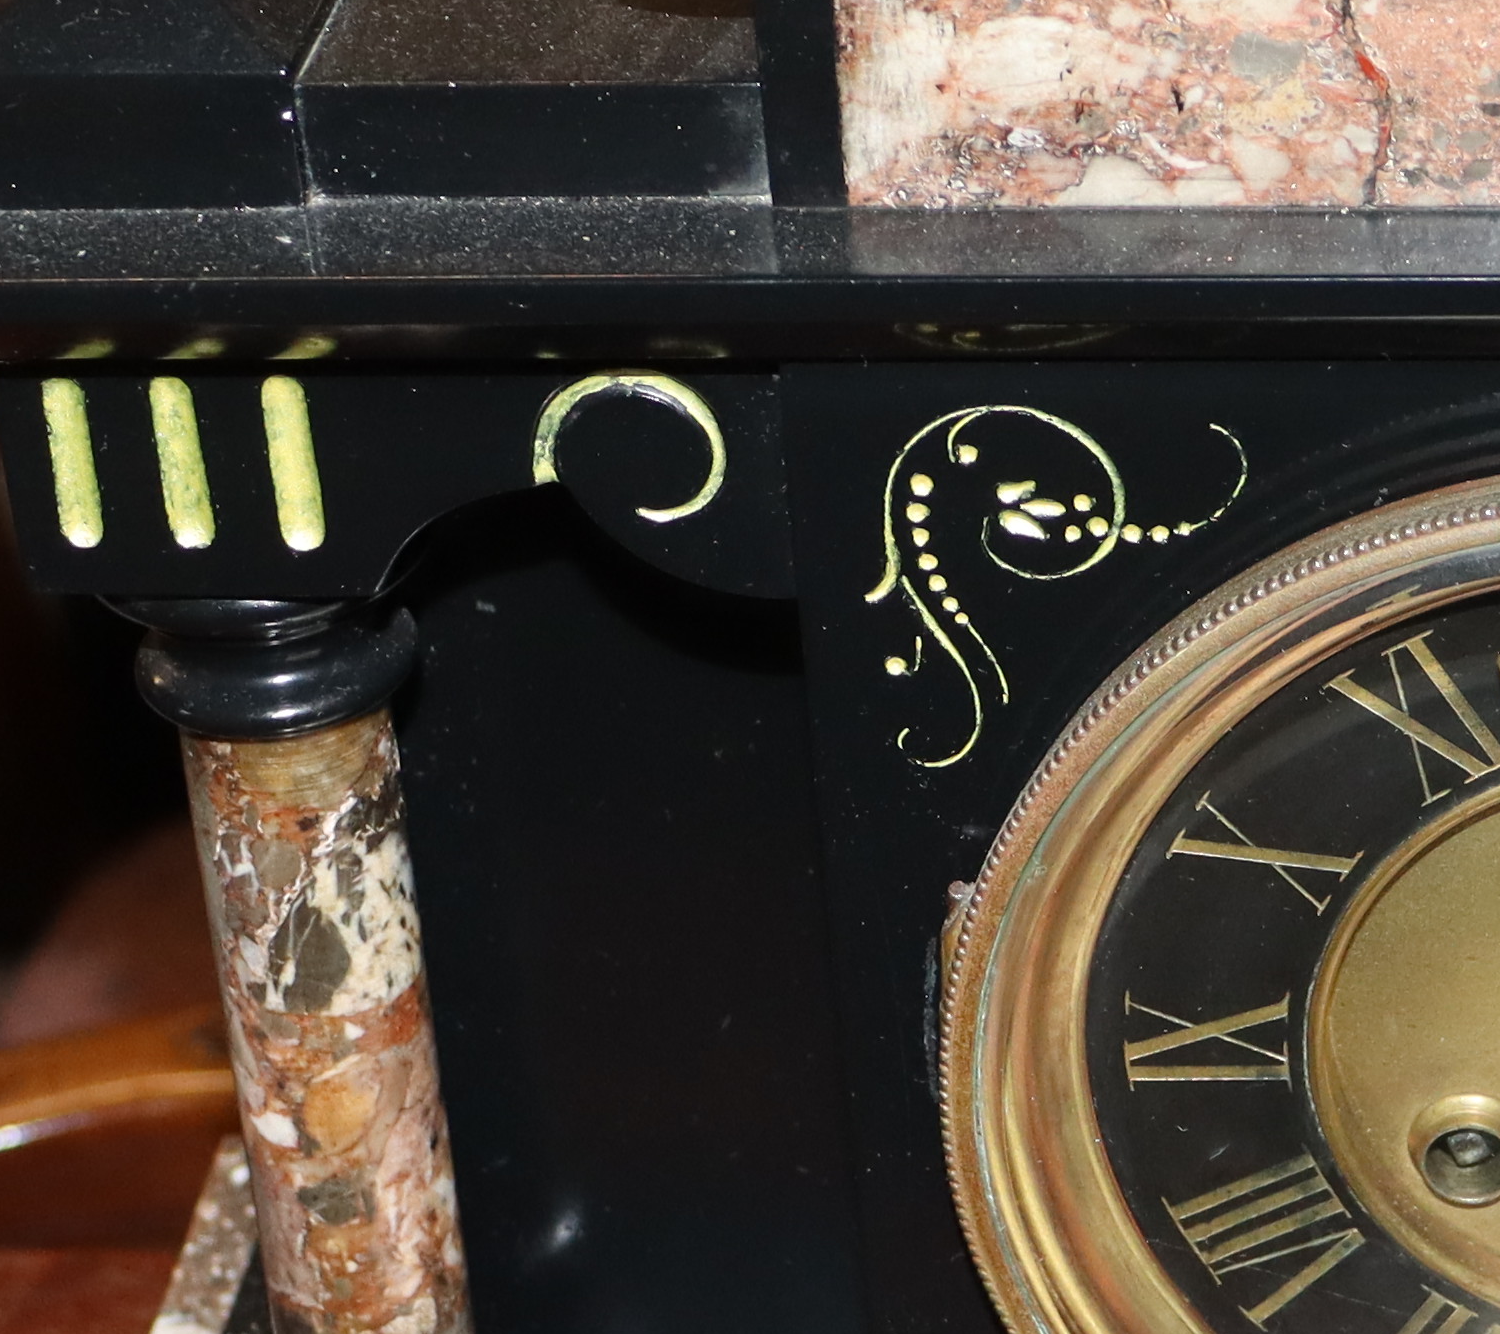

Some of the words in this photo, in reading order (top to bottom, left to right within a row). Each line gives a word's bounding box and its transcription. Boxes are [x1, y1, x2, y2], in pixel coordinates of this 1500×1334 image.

[1167, 791, 1365, 915] X
[1126, 991, 1290, 1090] IX
[1161, 1153, 1365, 1330] VIII
